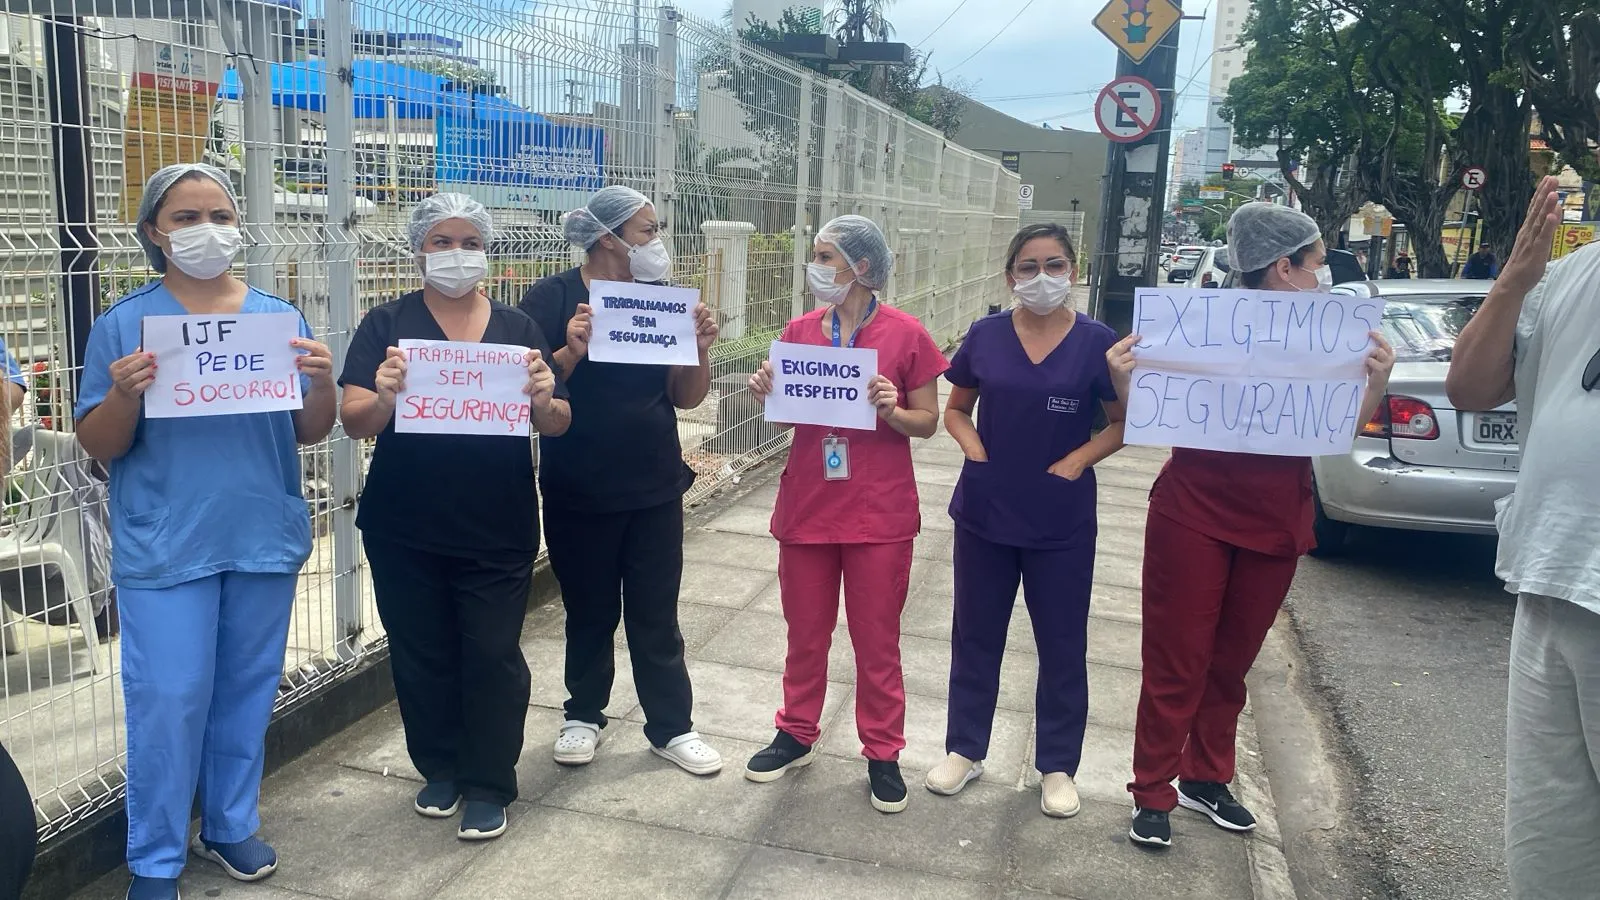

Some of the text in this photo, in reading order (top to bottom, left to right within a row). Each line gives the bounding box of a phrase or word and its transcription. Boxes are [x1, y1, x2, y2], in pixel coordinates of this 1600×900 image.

[1115, 92, 1140, 127] E
[602, 296, 687, 314] TRABALHAMOS
[632, 315, 657, 328] SEM
[1133, 294, 1377, 354] EXIGIMOS
[182, 320, 237, 346] IJF
[608, 330, 678, 348] SEGURANÇA
[196, 351, 264, 375] PEDE
[406, 347, 530, 368] TRABALHAMOS
[781, 359, 861, 379] EXIGIMOS
[174, 373, 296, 406] SOCORRO!
[436, 370, 483, 391] SEM
[784, 383, 858, 401] RESPEITO
[402, 395, 530, 432] SEGURANÇA
[1130, 372, 1360, 444] SEGURANÇA
